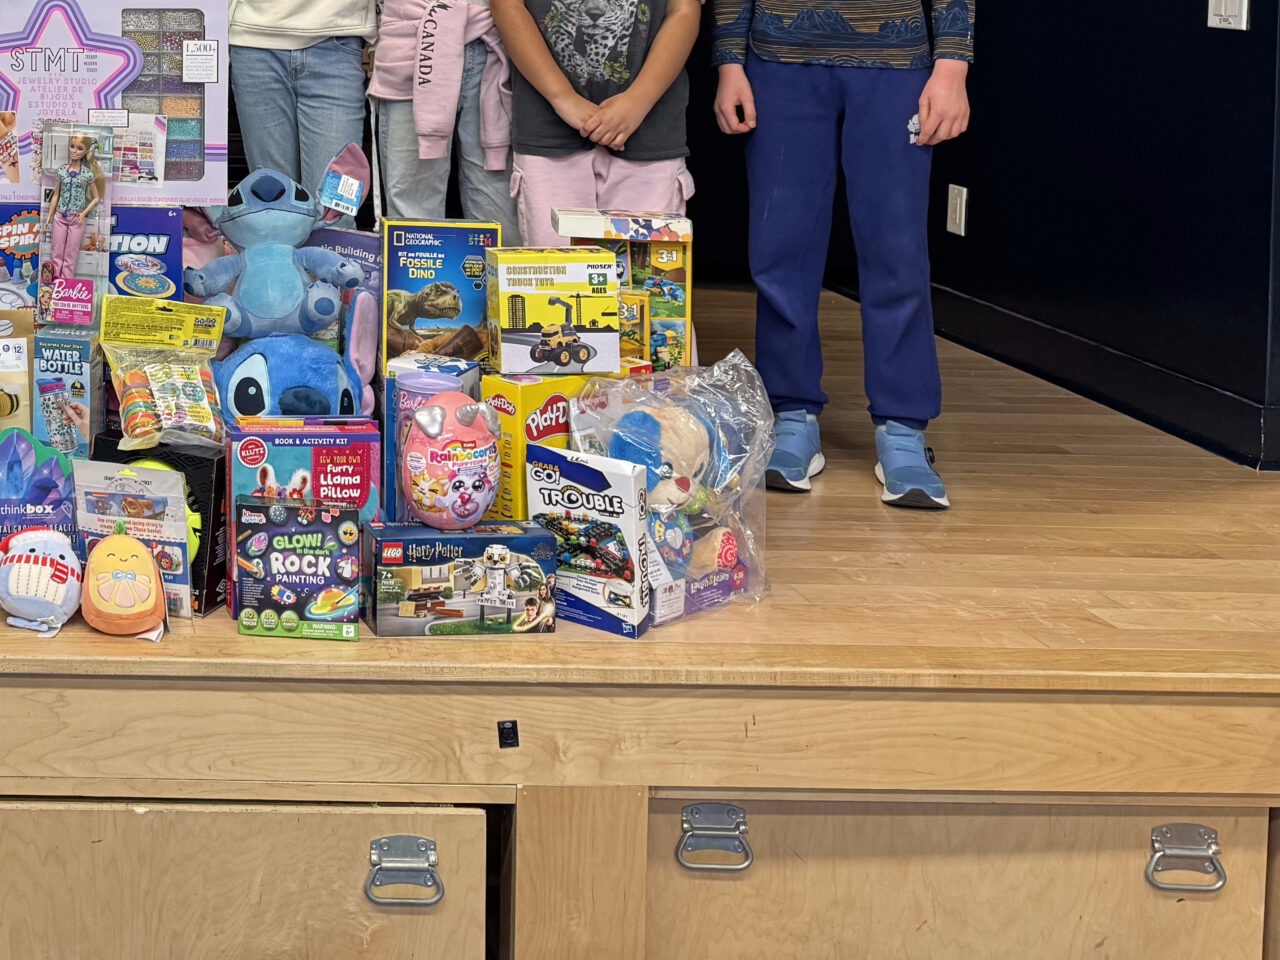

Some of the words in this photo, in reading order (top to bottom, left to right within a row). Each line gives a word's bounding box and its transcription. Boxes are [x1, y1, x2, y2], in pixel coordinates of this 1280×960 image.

[10, 47, 85, 72] STMT
[418, 19, 438, 86] CANADA
[335, 246, 376, 263] Building
[400, 257, 443, 268] FOSSILE
[409, 268, 435, 279] DINO
[506, 266, 567, 275] CONSTRUCTION
[506, 278, 533, 287] TRUCK
[535, 278, 555, 287] TOYS
[592, 274, 604, 284] 3+
[52, 279, 91, 300] Barbie
[13, 346, 22, 354] 12
[41, 348, 80, 362] WATER
[39, 361, 82, 375] BOTTLE
[486, 397, 516, 414] Play-Doh
[526, 401, 569, 437] Play-D
[241, 448, 265, 456] KLUTZ
[429, 442, 498, 464] Rainbocorns
[327, 464, 354, 474] Furry
[532, 461, 554, 471] GRAB
[531, 468, 560, 485] GO!
[540, 489, 624, 514] TROUBLE
[0, 503, 54, 515] thinkbox
[273, 534, 322, 549] GLOW!
[383, 548, 401, 558] LEGO
[407, 543, 434, 561] Harry
[435, 542, 464, 559] Potter
[269, 551, 332, 577] ROCK
[638, 533, 649, 607] TROUBLE
[276, 574, 325, 584] PAINTING
[381, 571, 392, 579] 7+
[691, 577, 709, 593] Laugh
[713, 572, 729, 586] Learn
